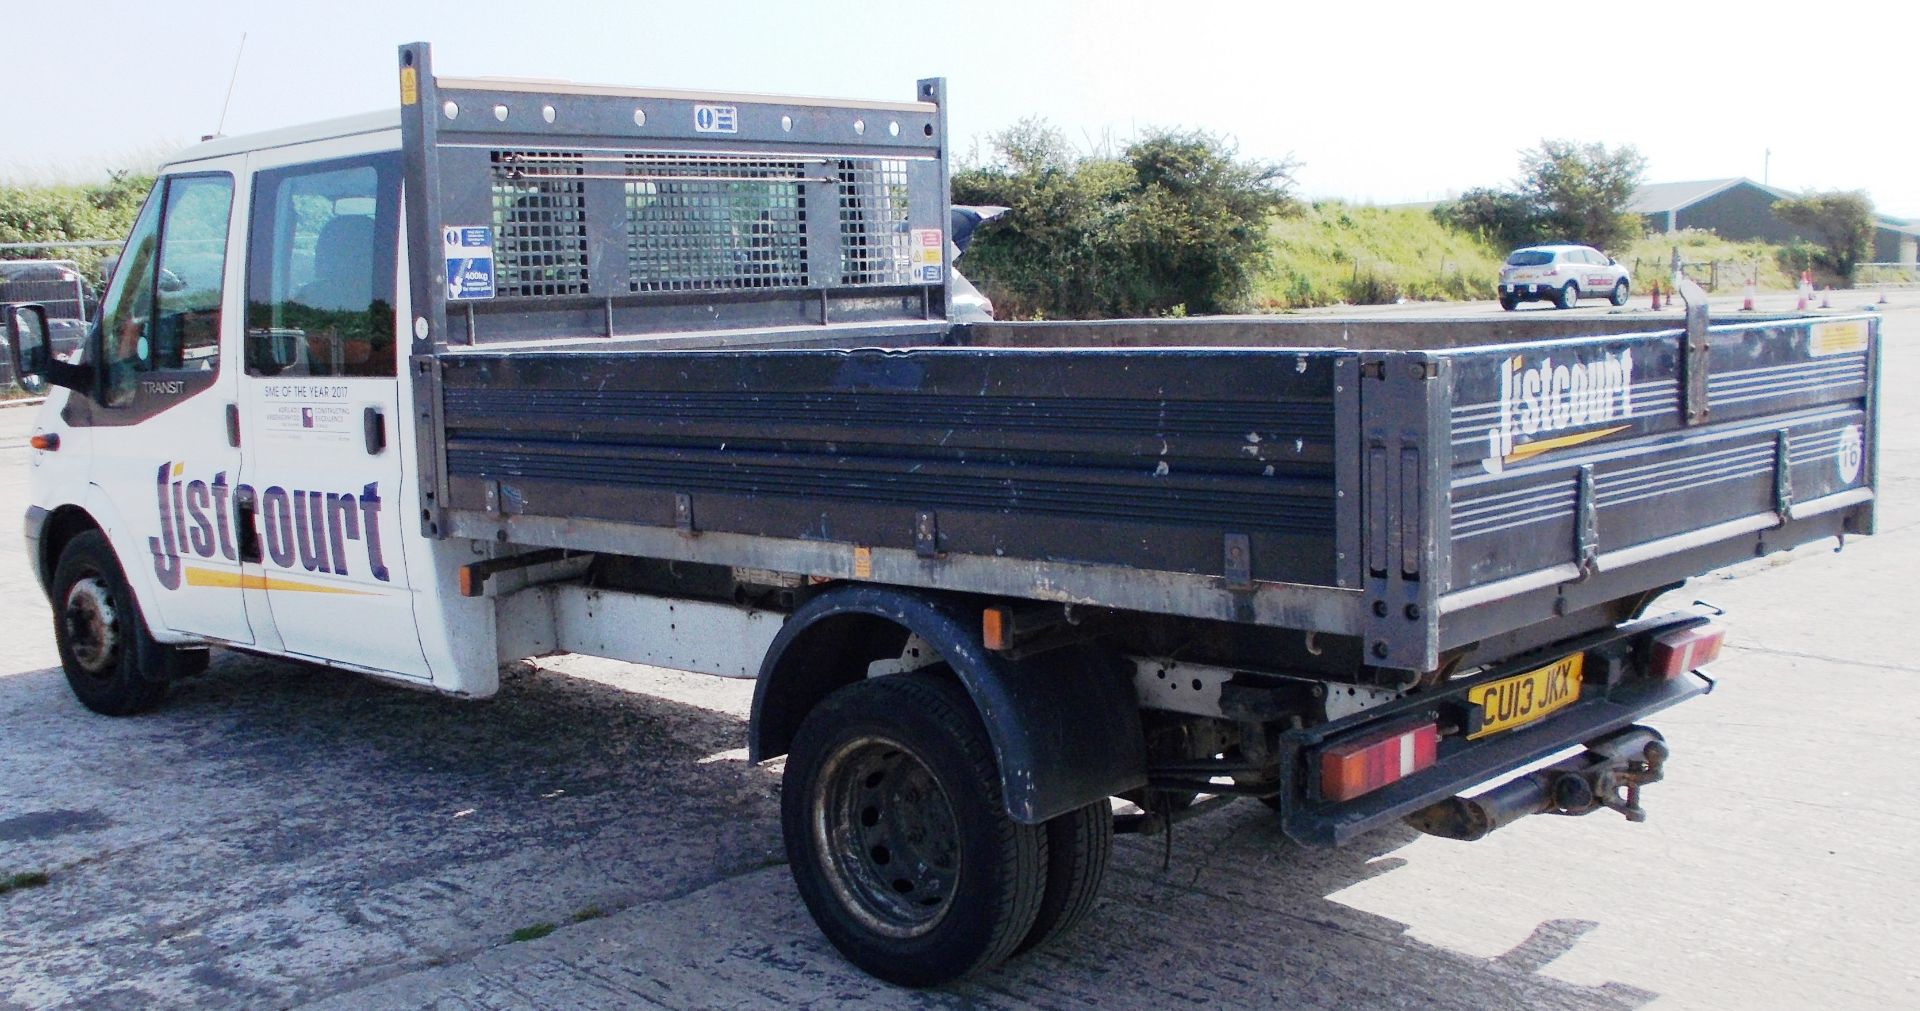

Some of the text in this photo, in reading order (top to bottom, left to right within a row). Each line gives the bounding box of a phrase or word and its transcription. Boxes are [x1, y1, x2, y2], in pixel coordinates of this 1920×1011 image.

[466, 271, 489, 281] 400kg
[142, 381, 184, 394] TRANSIT
[264, 386, 348, 398] SME OF THE YEAR 2017
[1481, 347, 1633, 475] Jistcourt
[1841, 441, 1858, 467] 16
[1483, 660, 1572, 726] CU13 JKX
